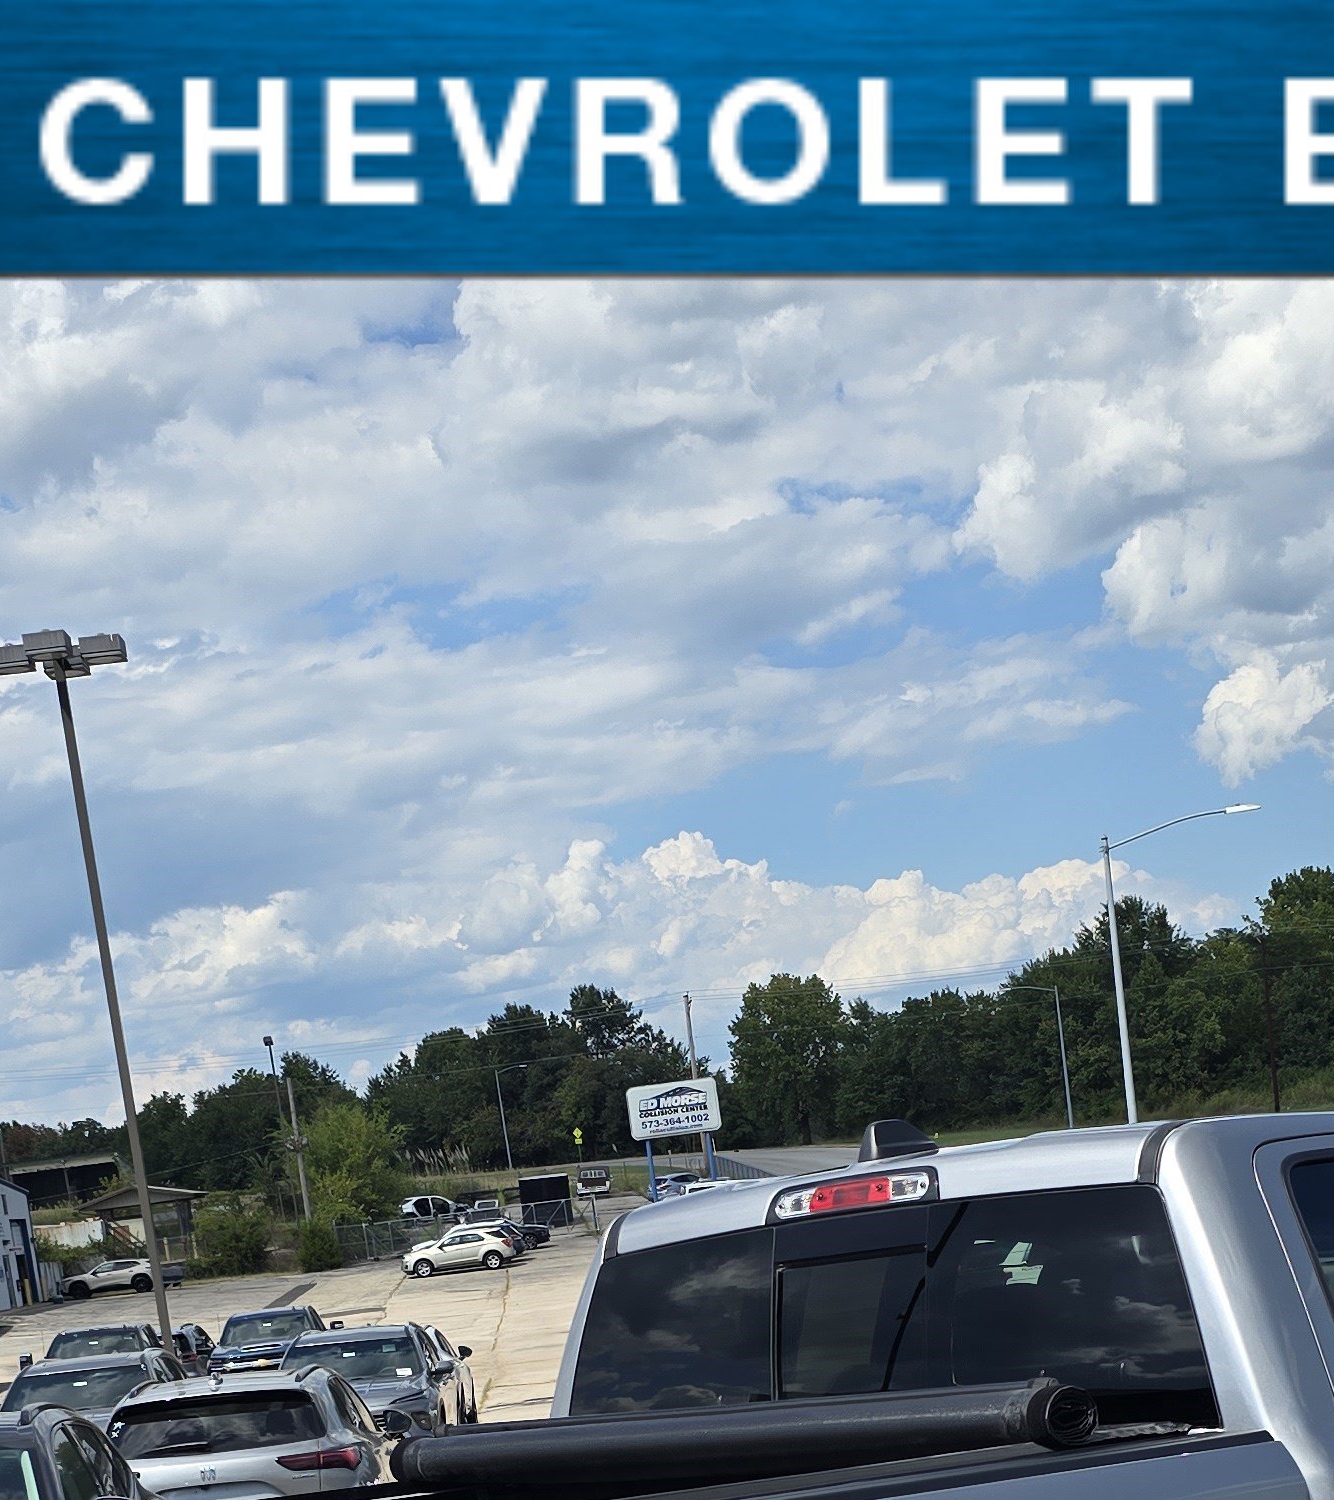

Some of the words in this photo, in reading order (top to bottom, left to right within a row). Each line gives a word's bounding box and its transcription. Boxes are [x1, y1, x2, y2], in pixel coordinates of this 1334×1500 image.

[639, 1098, 658, 1111] ED
[660, 1092, 707, 1109] MORSE
[639, 1108, 679, 1119] COLLISION
[681, 1105, 709, 1114] CENTER
[641, 1113, 710, 1130] 573-364-1002
